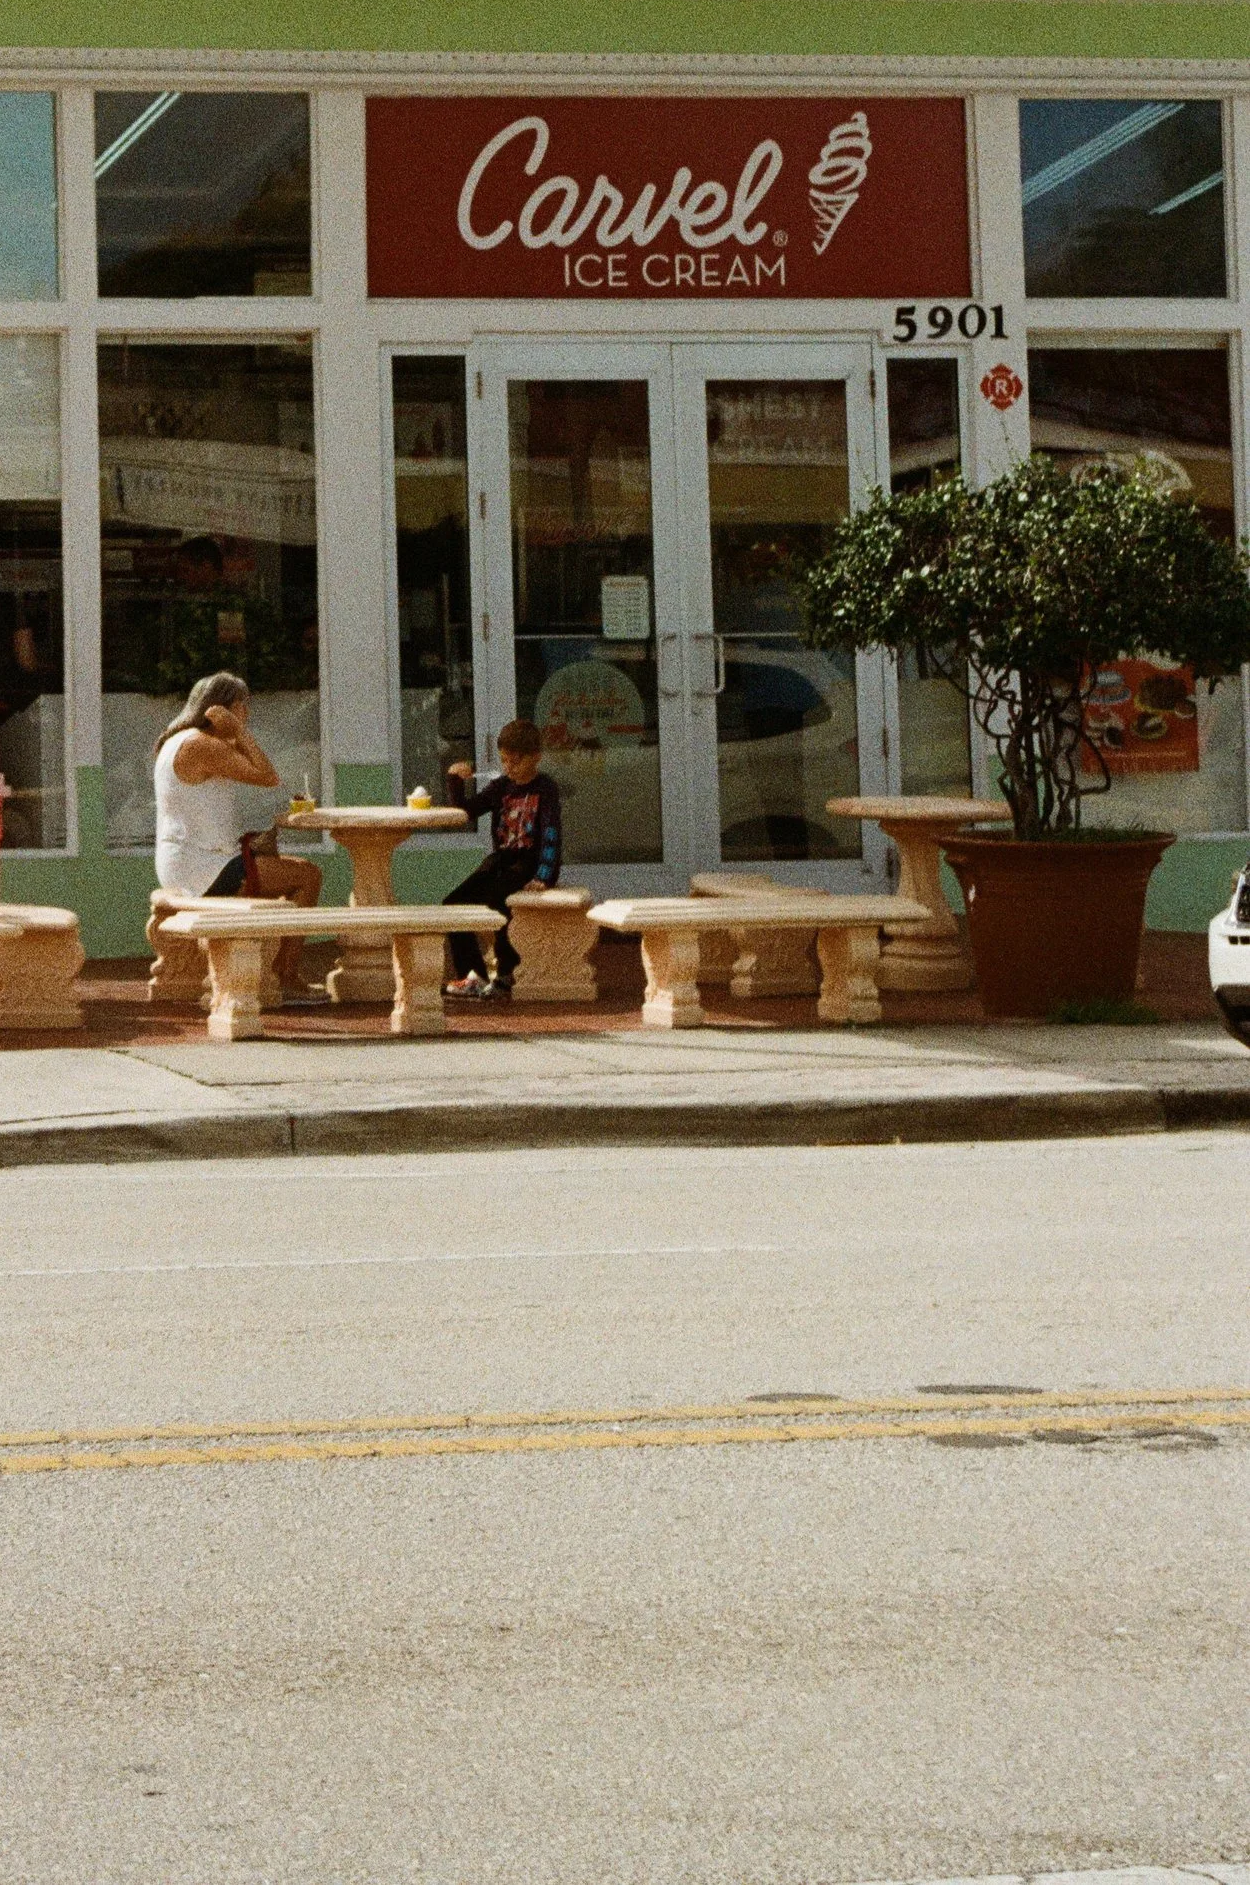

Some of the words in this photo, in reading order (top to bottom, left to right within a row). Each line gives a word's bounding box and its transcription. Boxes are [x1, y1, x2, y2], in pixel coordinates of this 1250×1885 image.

[456, 115, 784, 251] Carvel
[563, 253, 629, 287] ICE
[641, 253, 787, 287] CREAM
[892, 303, 1009, 343] 5901
[994, 377, 1009, 395] R
